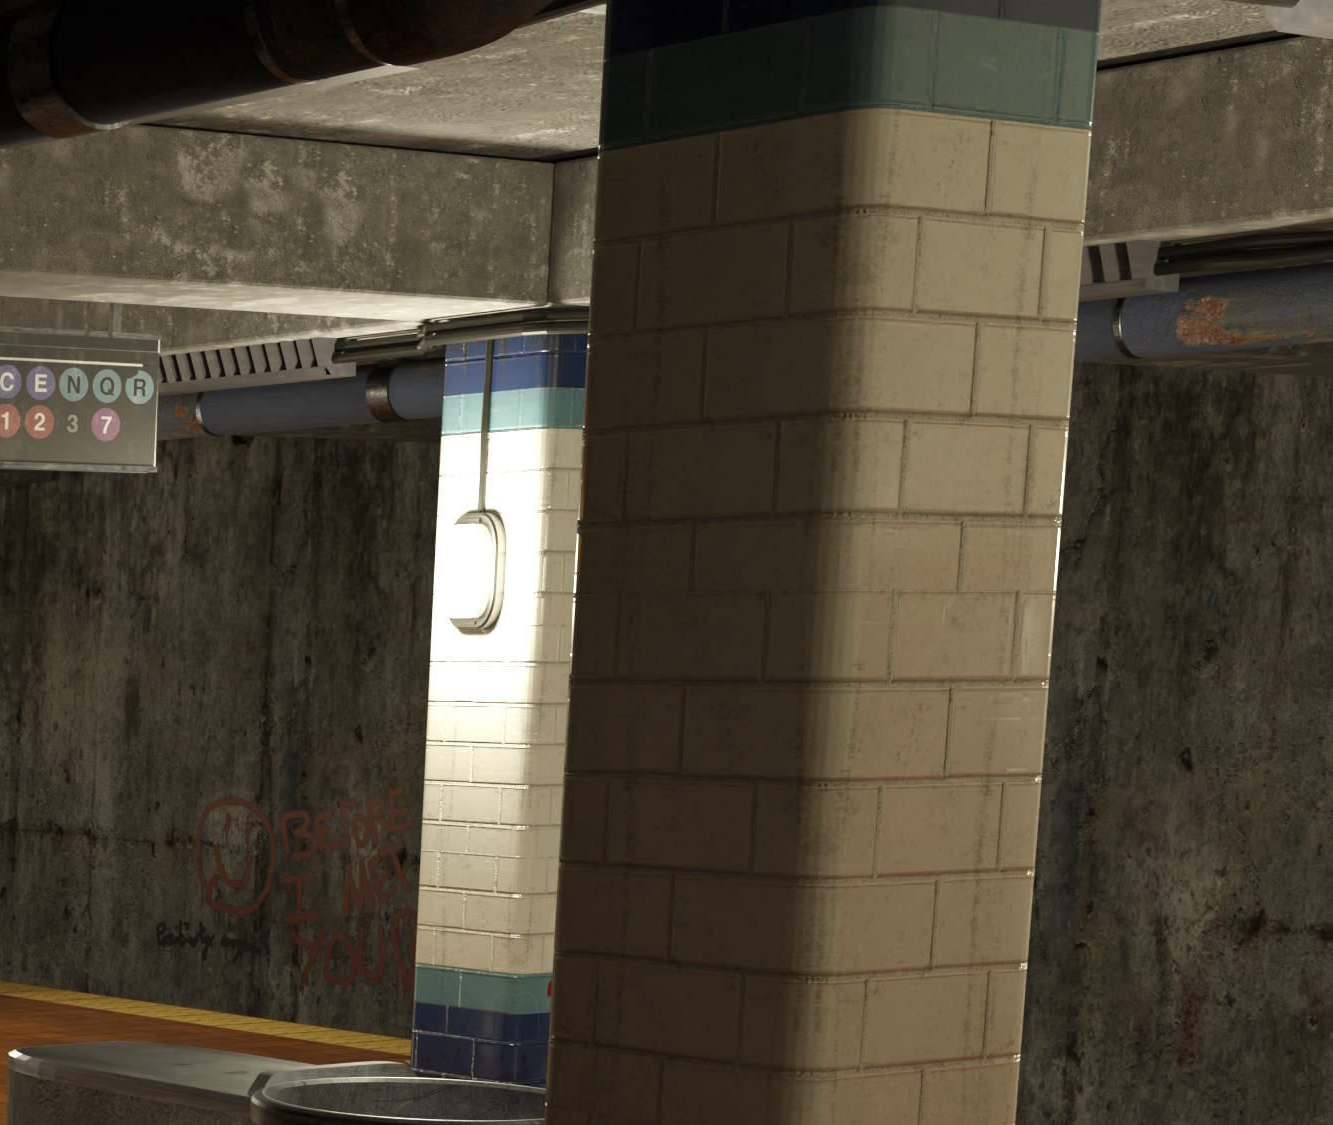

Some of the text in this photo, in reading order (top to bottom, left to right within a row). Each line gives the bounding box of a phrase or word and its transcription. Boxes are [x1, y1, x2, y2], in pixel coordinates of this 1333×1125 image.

[0, 371, 15, 392] C
[34, 373, 48, 393] E
[67, 375, 81, 394] N
[99, 377, 114, 396] Q
[133, 378, 146, 397] R
[1, 412, 10, 430] 1
[34, 412, 46, 431] 2
[67, 414, 78, 433] 3
[100, 416, 113, 434] 7
[283, 787, 413, 863] BEFORE
[279, 843, 410, 923] I MET
